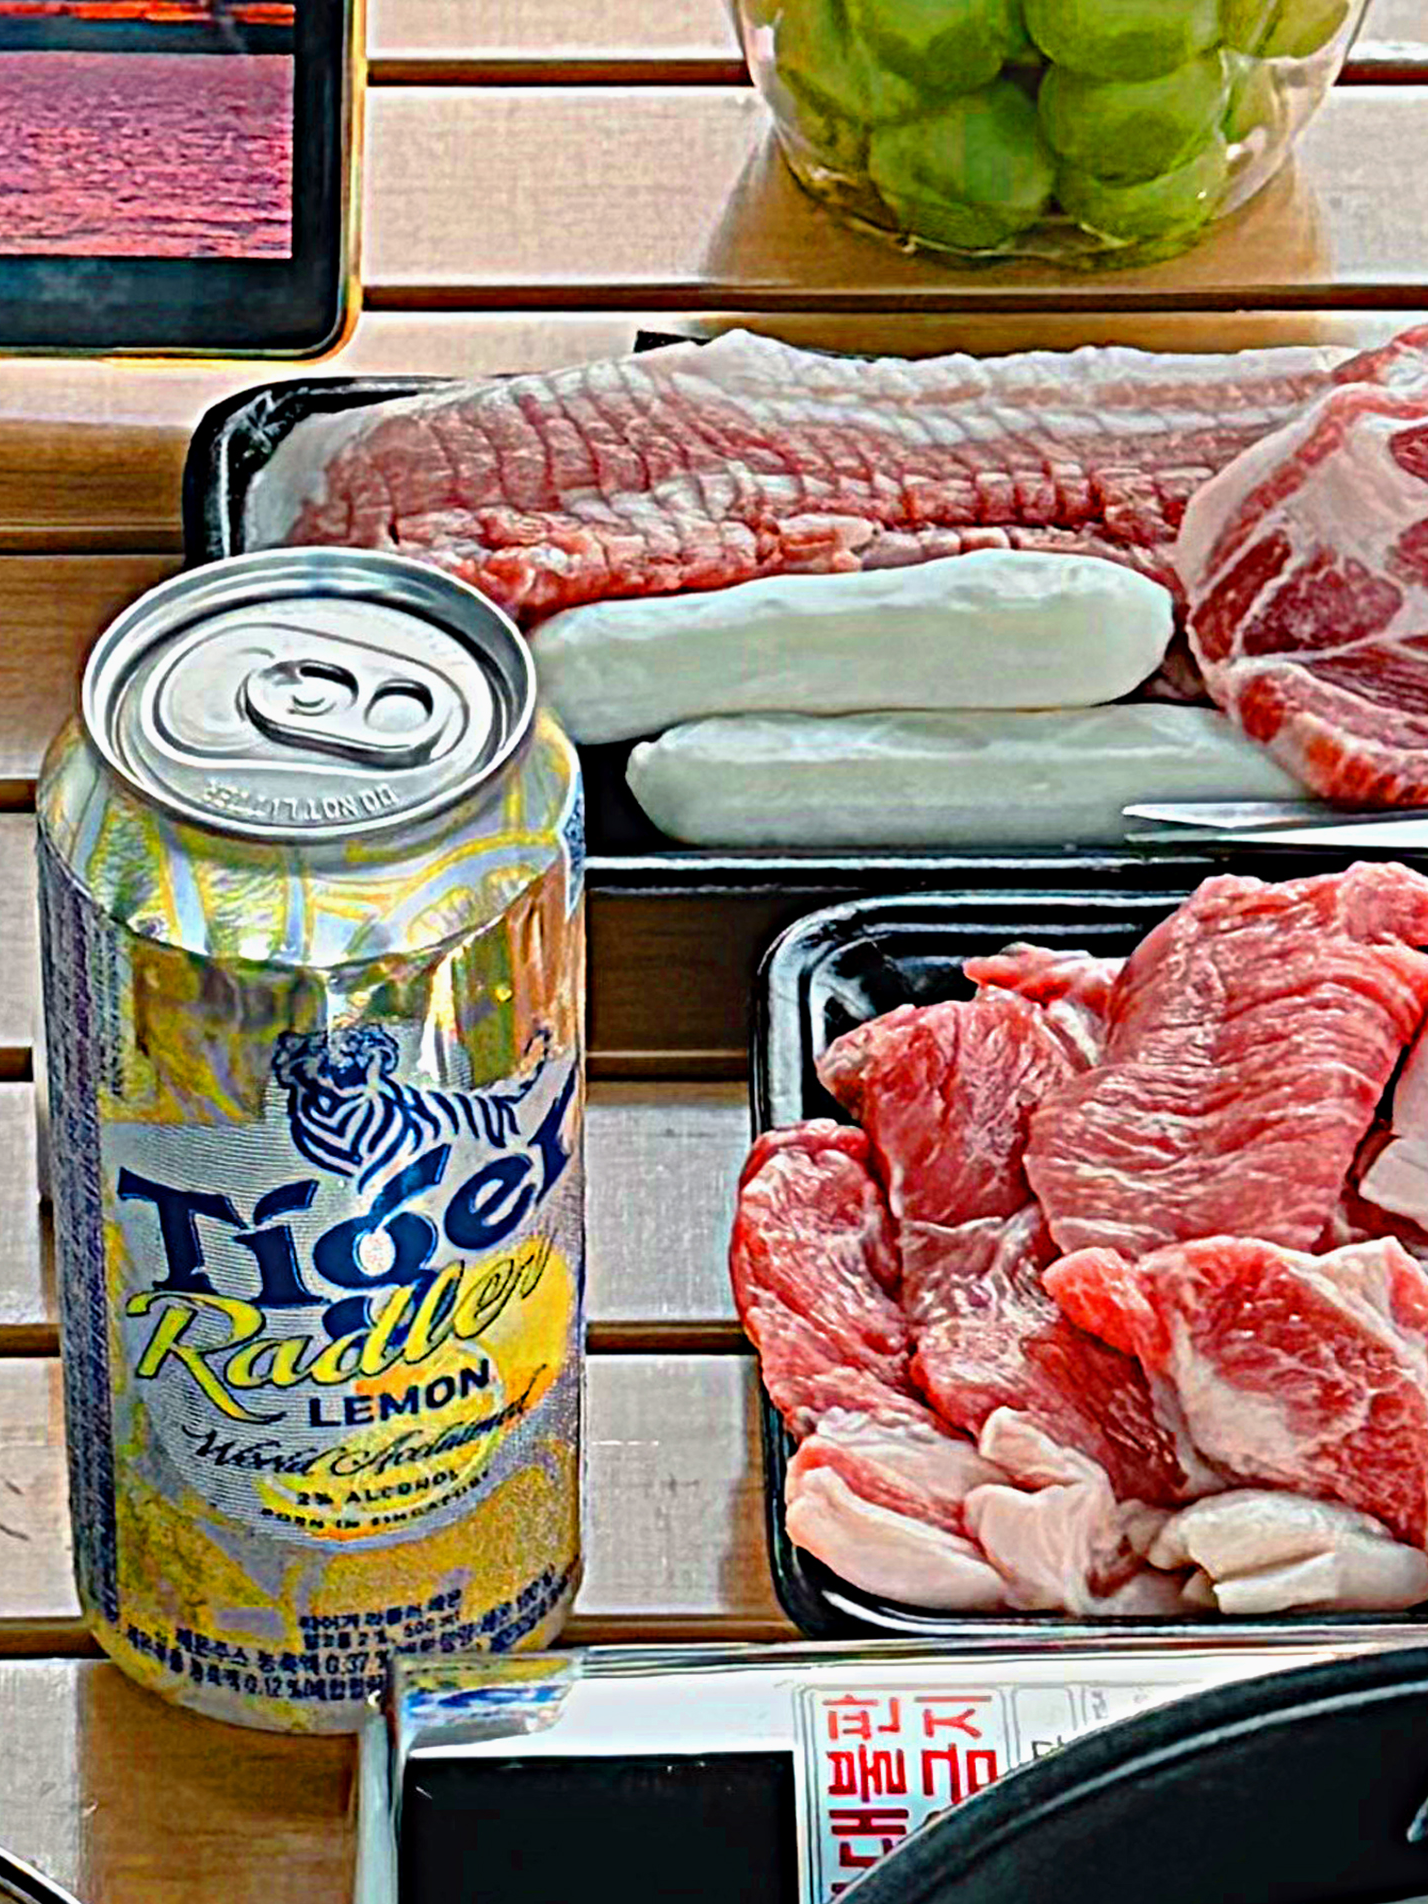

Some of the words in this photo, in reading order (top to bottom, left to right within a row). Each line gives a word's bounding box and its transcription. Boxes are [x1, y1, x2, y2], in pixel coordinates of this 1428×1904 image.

[117, 1063, 580, 1342] Tiger
[126, 1227, 557, 1424] Radler
[309, 1358, 491, 1428] LEMON
[345, 1470, 459, 1503] ALCOHOL
[822, 1693, 909, 1896] 대불판
